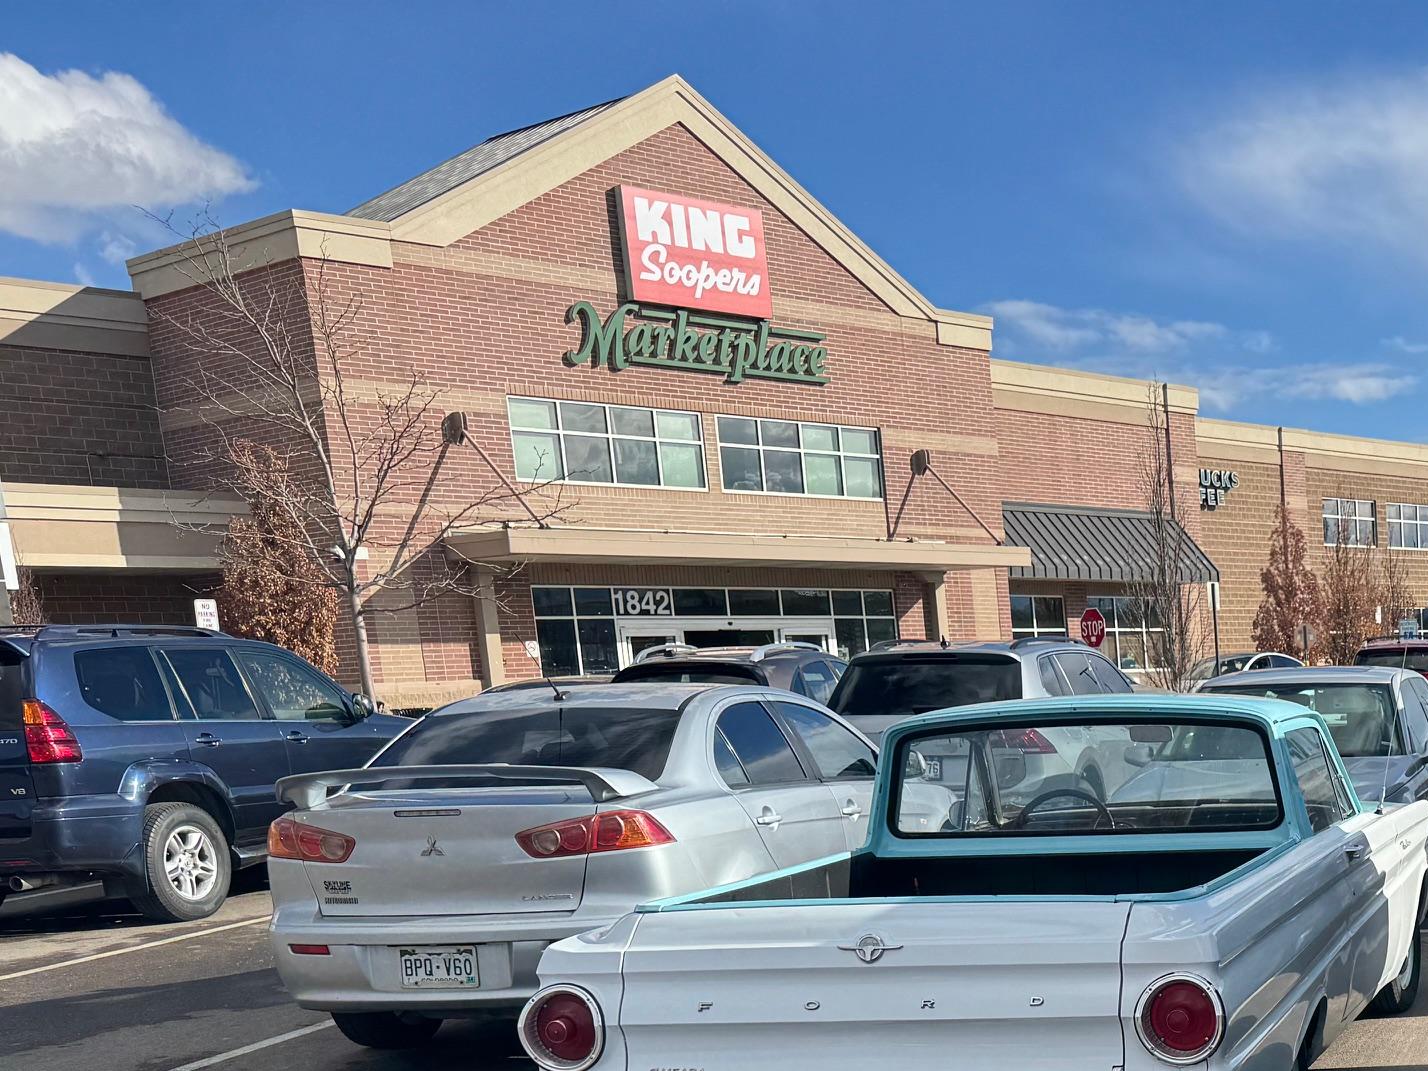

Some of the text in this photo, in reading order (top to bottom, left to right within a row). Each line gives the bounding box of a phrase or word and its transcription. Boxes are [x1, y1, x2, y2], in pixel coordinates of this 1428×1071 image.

[633, 196, 756, 258] KING
[639, 243, 761, 299] Soopers
[563, 299, 830, 384] Marketplace
[613, 590, 671, 615] 1842
[1081, 620, 1104, 637] STOP
